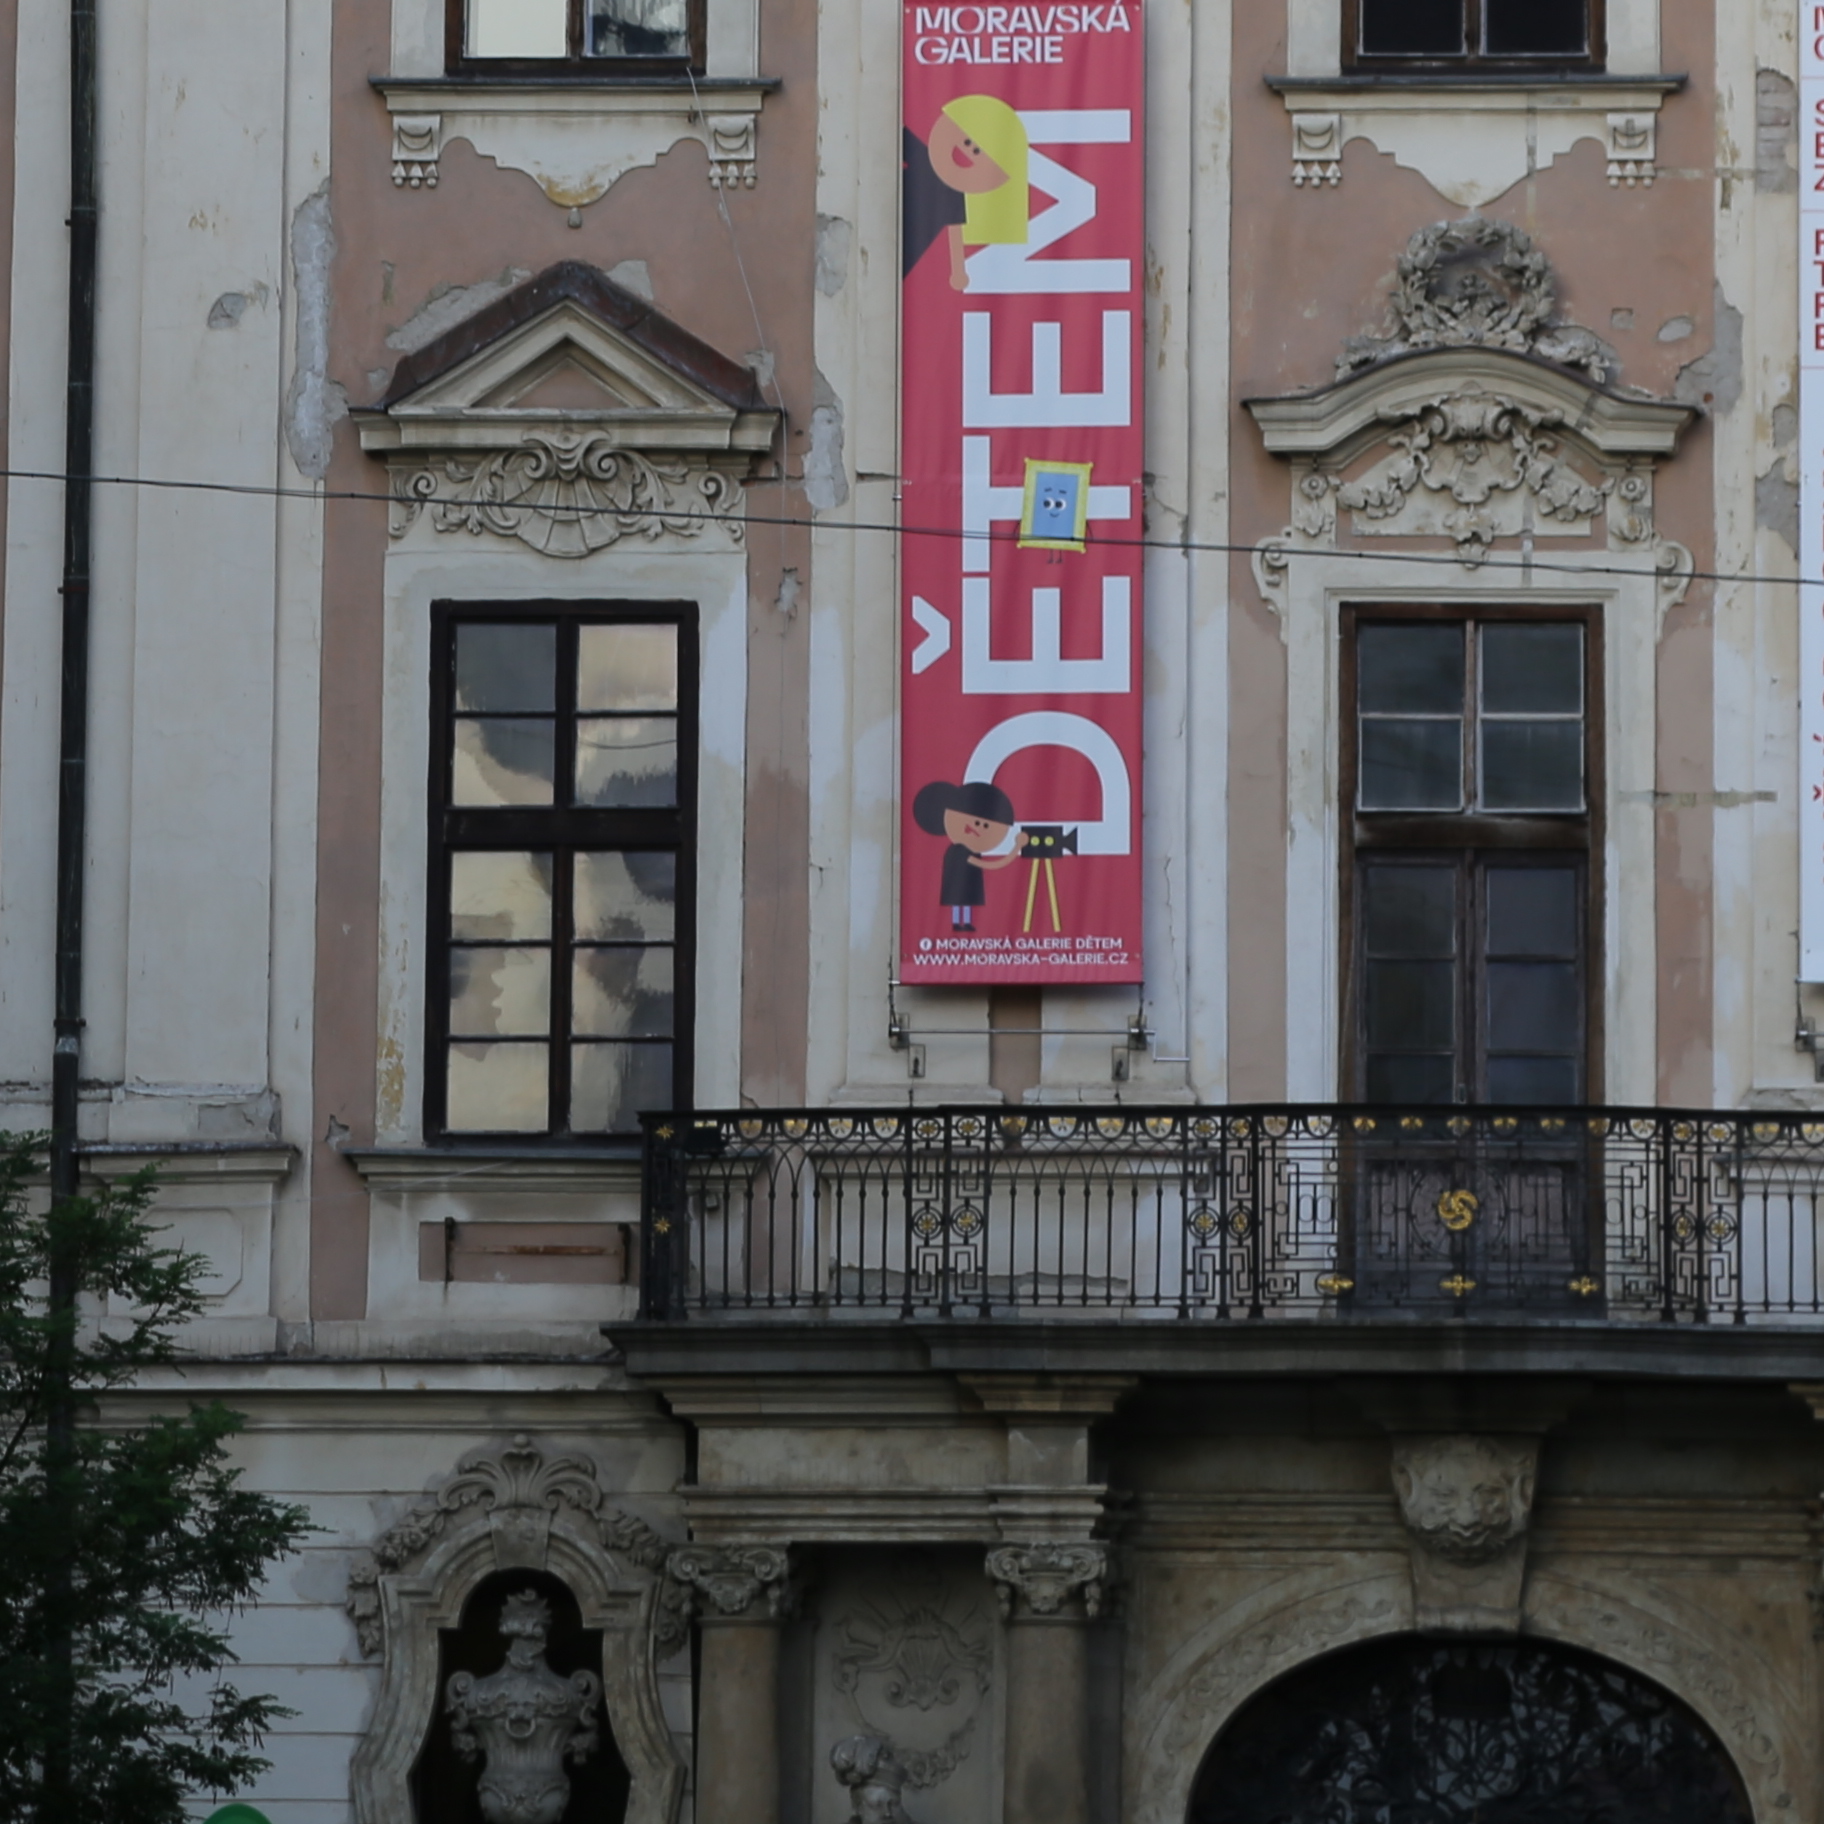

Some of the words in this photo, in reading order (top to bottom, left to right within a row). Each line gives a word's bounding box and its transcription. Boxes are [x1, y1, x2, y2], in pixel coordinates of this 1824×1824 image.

[915, 36, 1063, 63] GALERIE
[912, 108, 1132, 856] DĚTEM
[936, 937, 1011, 950] MORAVSKÁ
[1016, 938, 1071, 949] GALERIE
[1076, 936, 1122, 949] DĚTEM
[914, 953, 1128, 965] WWW.MORAVSKA-GALERIE.CZ
